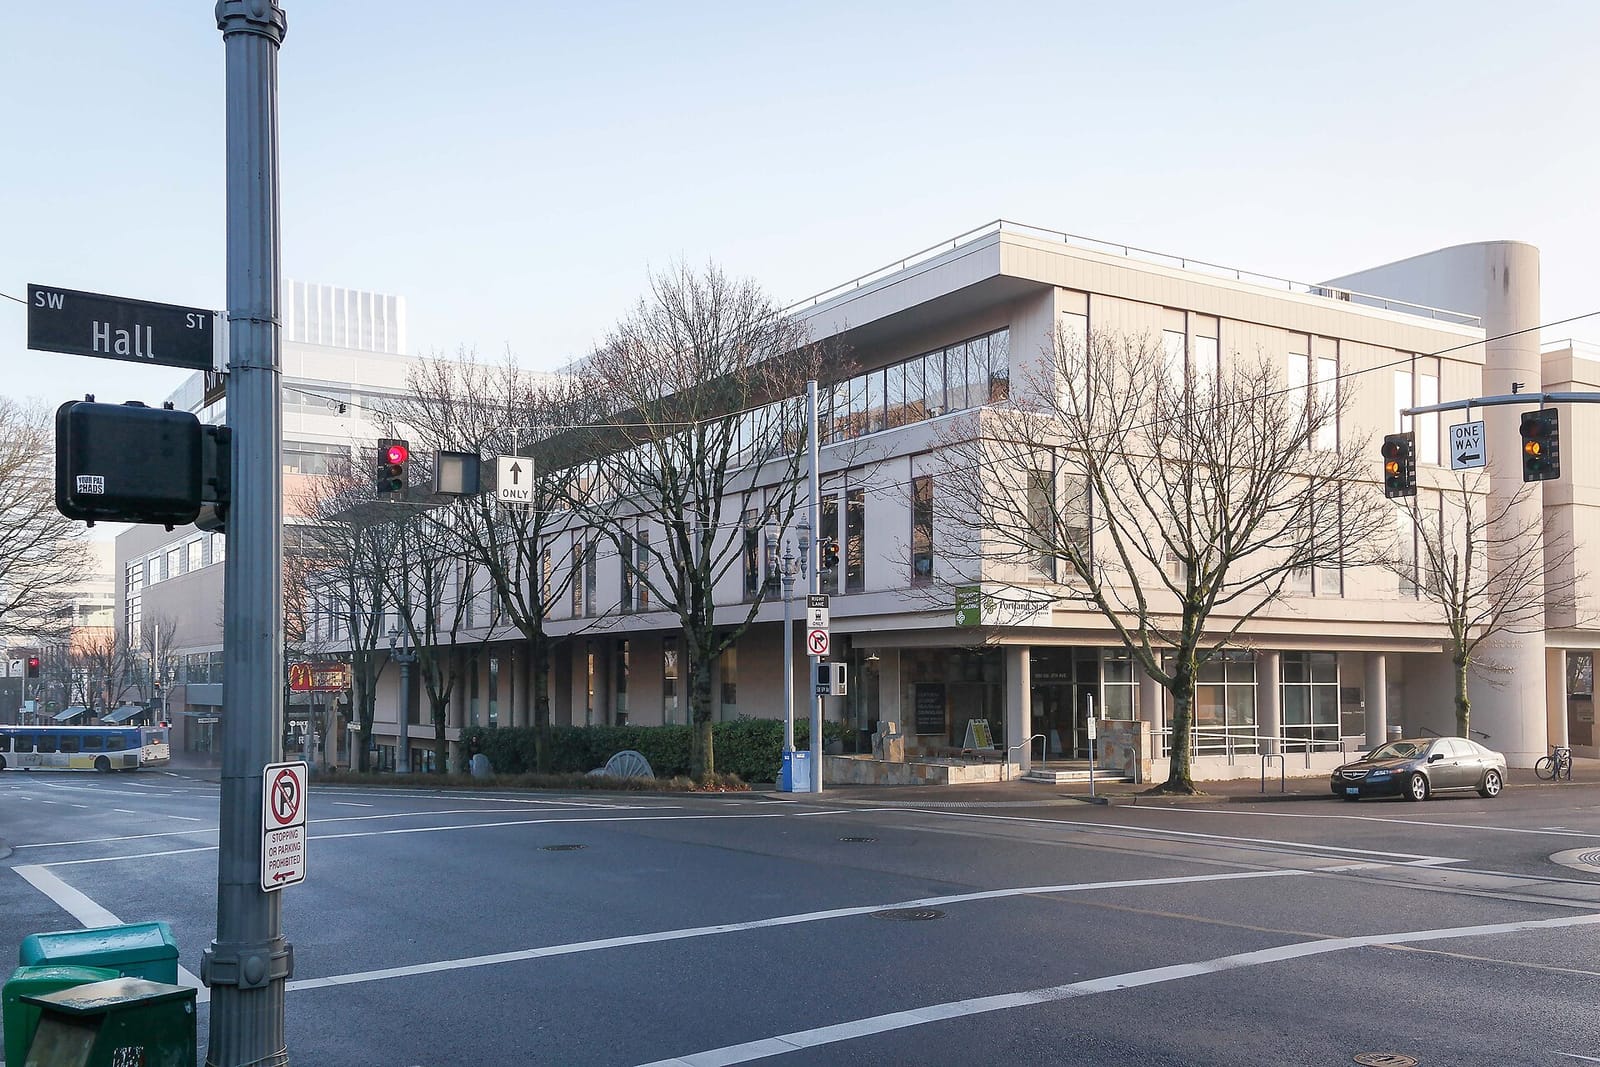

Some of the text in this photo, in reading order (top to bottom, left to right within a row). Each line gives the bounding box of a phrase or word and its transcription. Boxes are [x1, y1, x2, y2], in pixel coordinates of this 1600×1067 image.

[35, 291, 205, 330] SW ST
[92, 320, 154, 359] Hall
[1455, 425, 1479, 438] ONE
[1455, 438, 1480, 451] WAY
[502, 488, 529, 499] ONLY
[271, 829, 299, 843] STOPPING
[268, 841, 301, 857] OR PARKING
[268, 854, 301, 871] PROHIBITED
